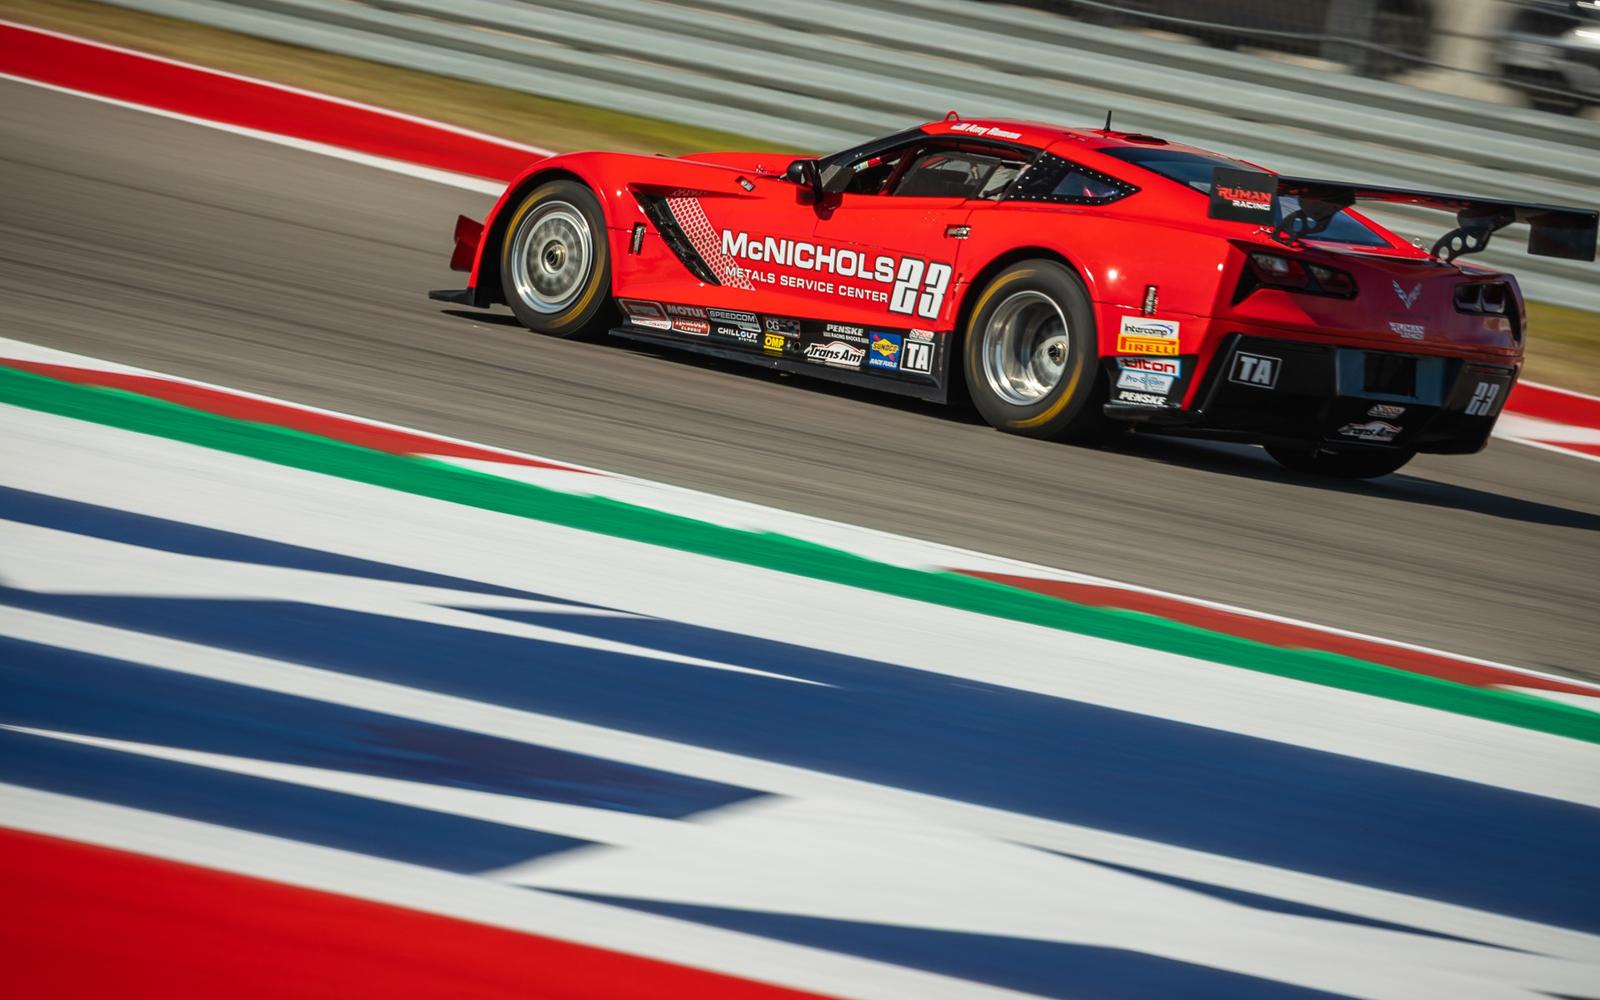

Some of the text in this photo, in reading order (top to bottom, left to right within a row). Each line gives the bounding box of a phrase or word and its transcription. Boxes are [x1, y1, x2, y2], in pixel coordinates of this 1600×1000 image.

[1217, 186, 1272, 204] RUMAN
[1232, 199, 1271, 211] RACING
[721, 229, 895, 282] McNICHOLS
[724, 264, 888, 304] METALS SERVICE CENTER
[888, 255, 953, 321] 23
[667, 305, 707, 318] MOTUL
[709, 310, 756, 323] SPEEDCOM
[718, 328, 758, 340] CHILLOUT
[826, 323, 864, 337] PENSKE
[1124, 322, 1168, 337] Intercomp
[764, 337, 785, 349] OMP
[872, 341, 899, 354] SUNOCO
[1120, 336, 1176, 355] PIRELLI
[810, 344, 861, 363] Trans Am
[906, 342, 931, 371] TA
[1238, 356, 1273, 384] TA
[1119, 391, 1167, 405] PENSKE
[1464, 382, 1500, 416] 23
